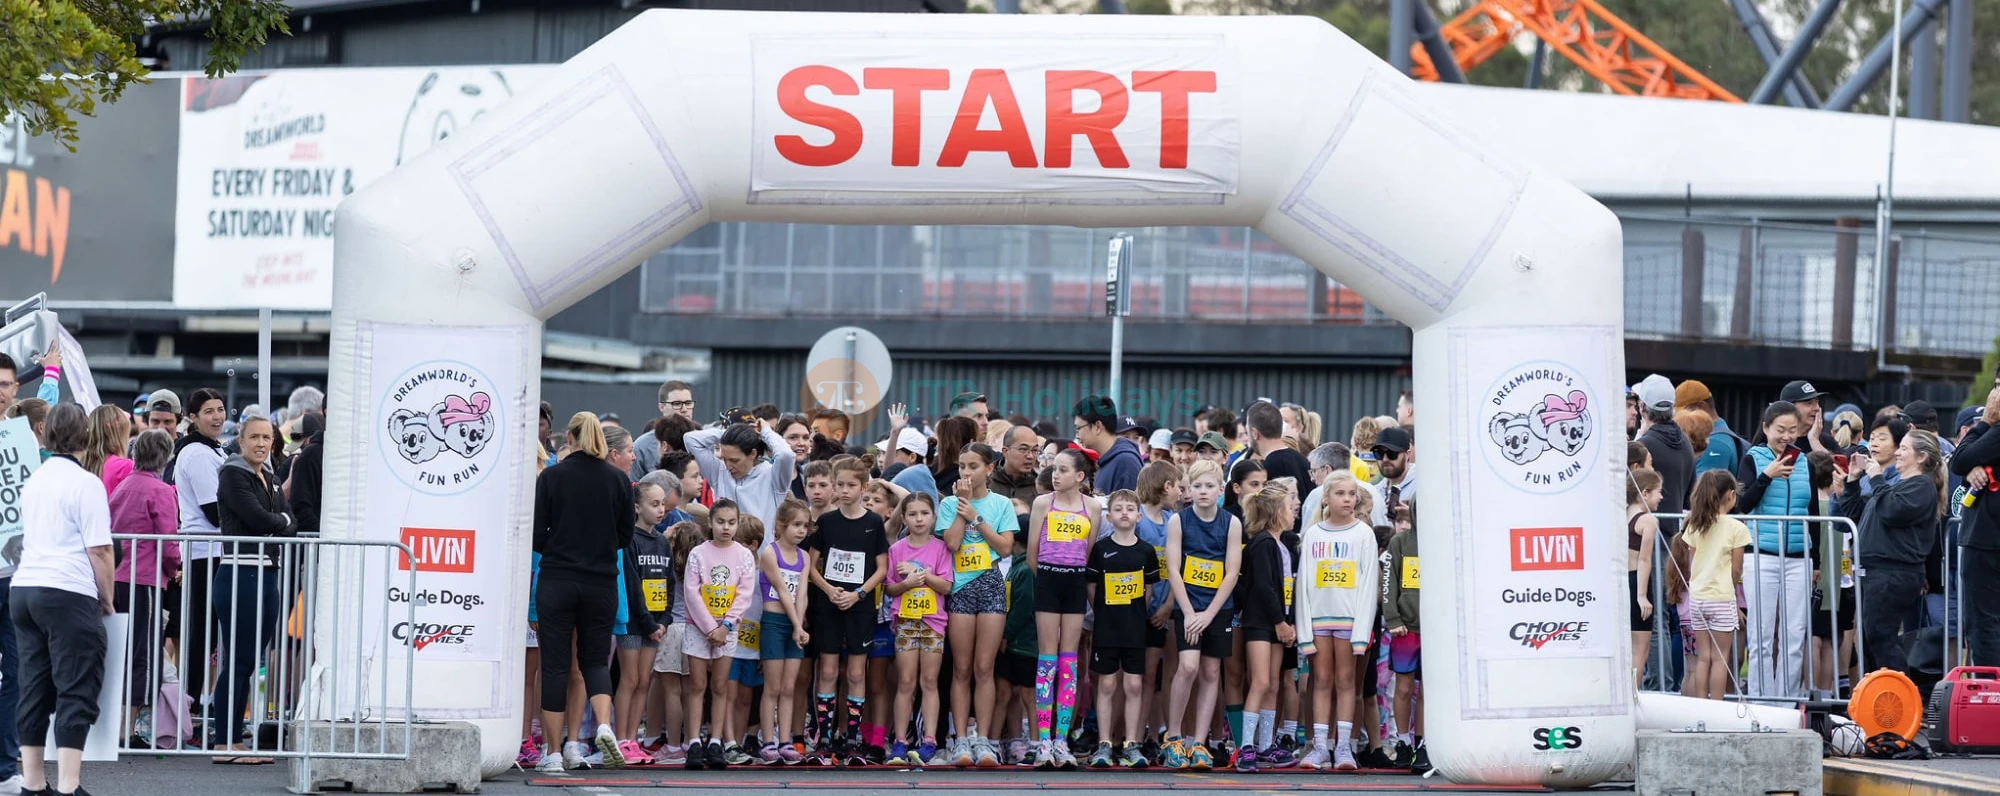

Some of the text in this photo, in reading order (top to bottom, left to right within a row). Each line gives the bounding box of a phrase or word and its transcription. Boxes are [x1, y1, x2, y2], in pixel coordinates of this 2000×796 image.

[774, 64, 1217, 168] START
[244, 113, 325, 149] DREAMWORLD
[213, 168, 354, 196] EVERY FRIDAY &
[208, 209, 334, 237] SATURDAY NIG
[394, 369, 478, 402] DREAMWORLD'S
[1492, 369, 1574, 406] DREAMWORLD'S
[419, 463, 479, 485] FUN RUN
[1525, 461, 1582, 485] FUN RUN
[1056, 522, 1082, 534] 2298
[409, 535, 467, 565] LIVIN
[1519, 535, 1576, 563] LIVIN
[833, 561, 855, 574] 4015
[961, 555, 982, 567] 2547
[1191, 569, 1216, 583] 2450
[1323, 571, 1347, 582] 2552
[388, 587, 484, 610] Gude Dogs.
[1114, 583, 1138, 595] 2297
[1502, 588, 1596, 607] Guide Dogs.
[709, 597, 731, 608] 2526
[907, 598, 930, 609] 2548
[391, 621, 475, 640] CHOICE
[738, 630, 756, 644] 226
[1509, 621, 1590, 641] CHOICE
